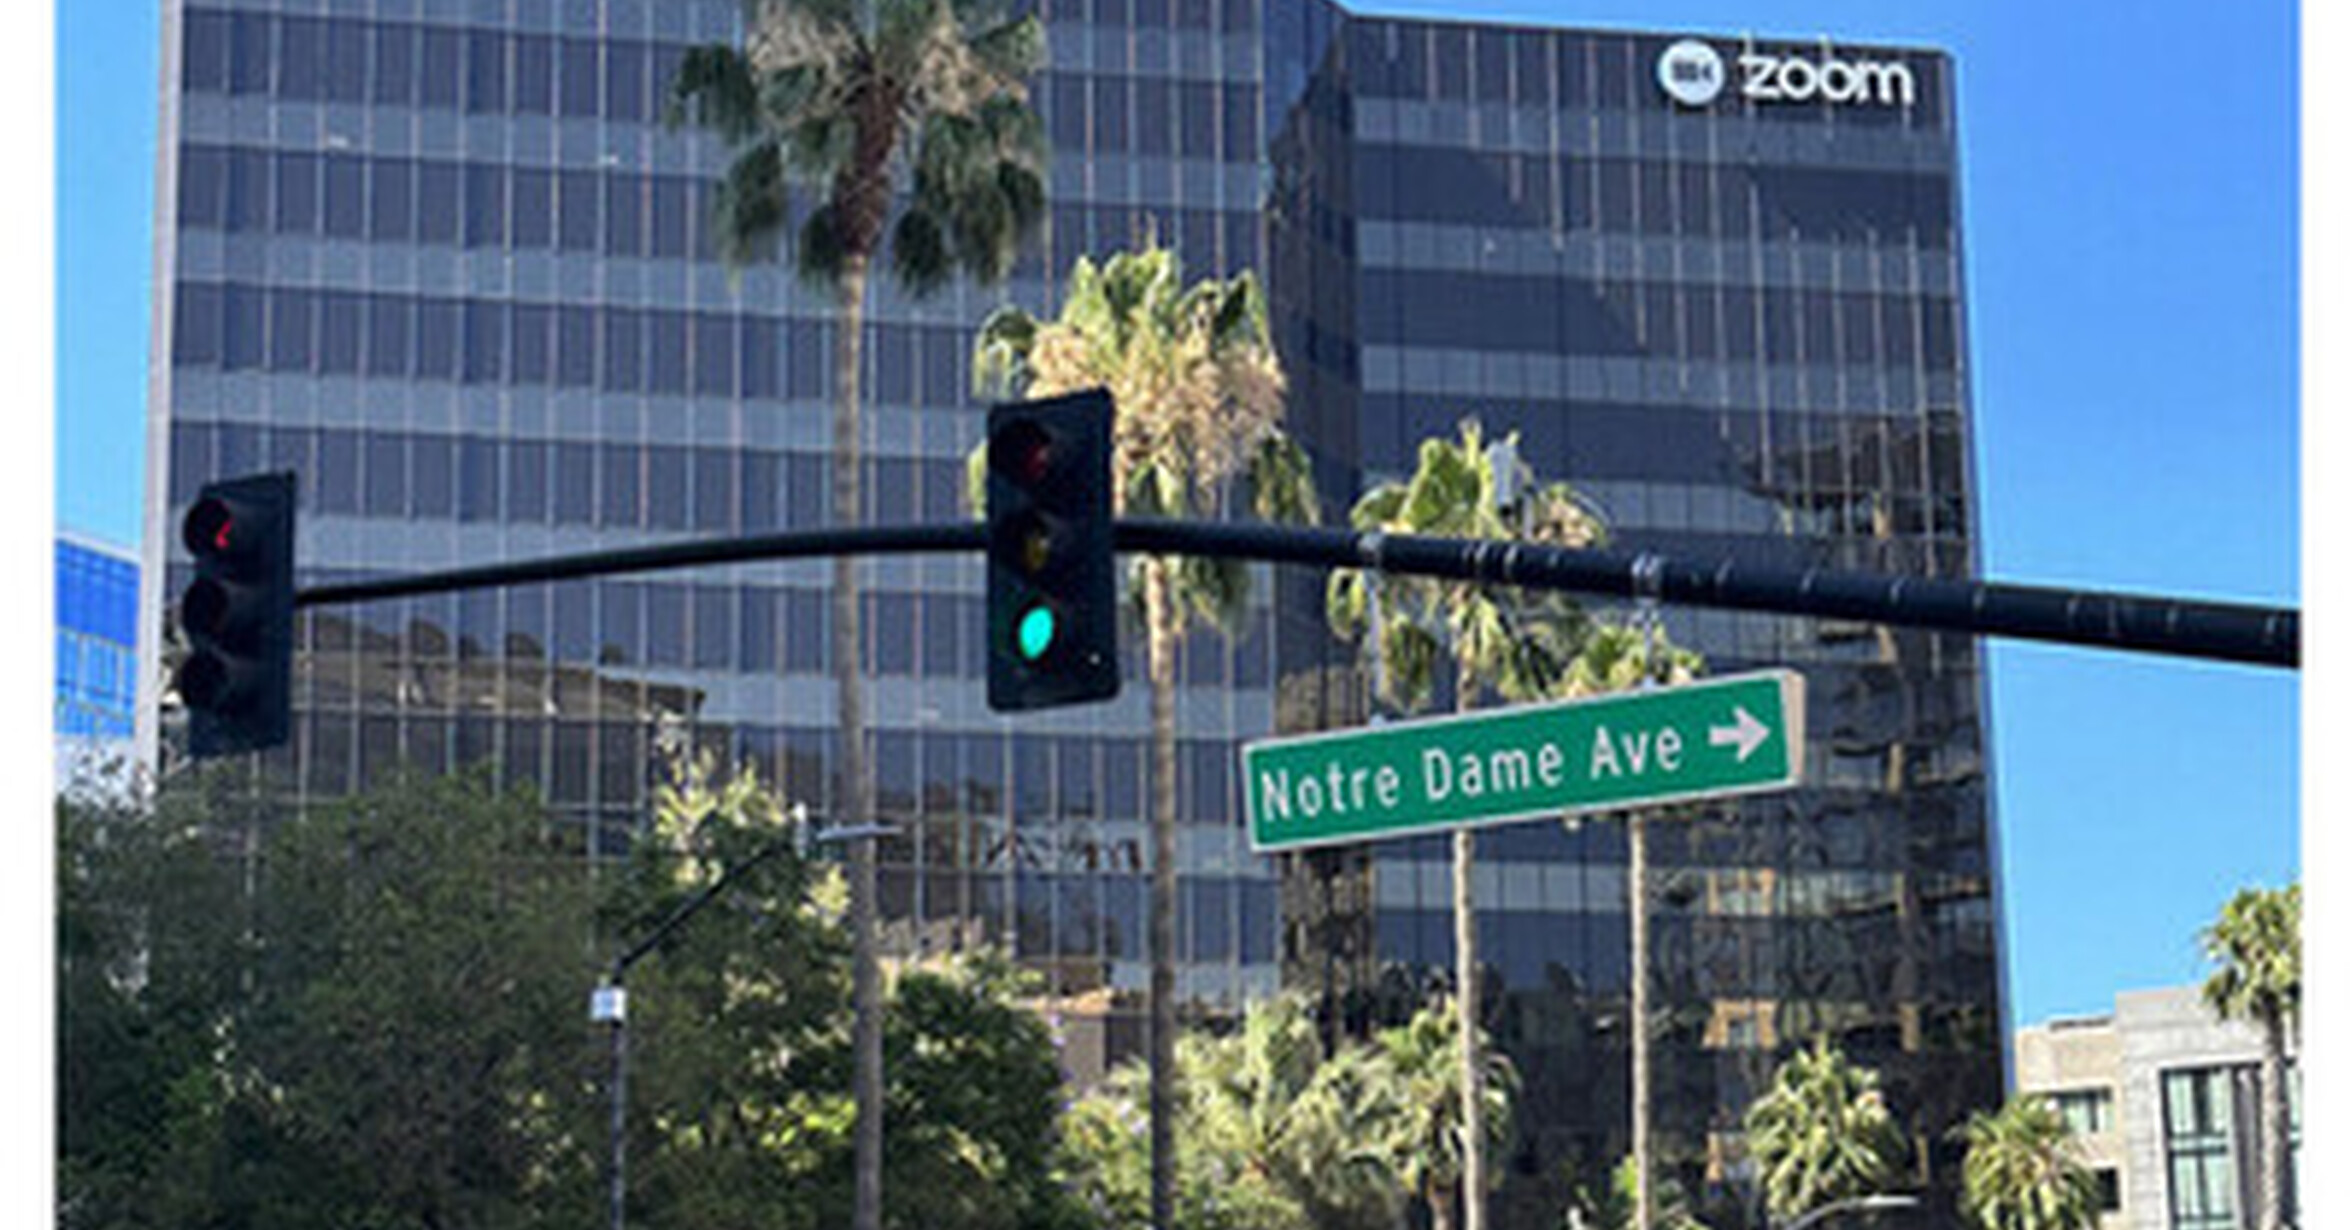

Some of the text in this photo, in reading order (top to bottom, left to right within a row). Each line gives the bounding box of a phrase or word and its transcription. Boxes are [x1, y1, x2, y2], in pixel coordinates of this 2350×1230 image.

[1738, 55, 1913, 104] zoom
[1261, 726, 1682, 821] Notre Dame Ave
